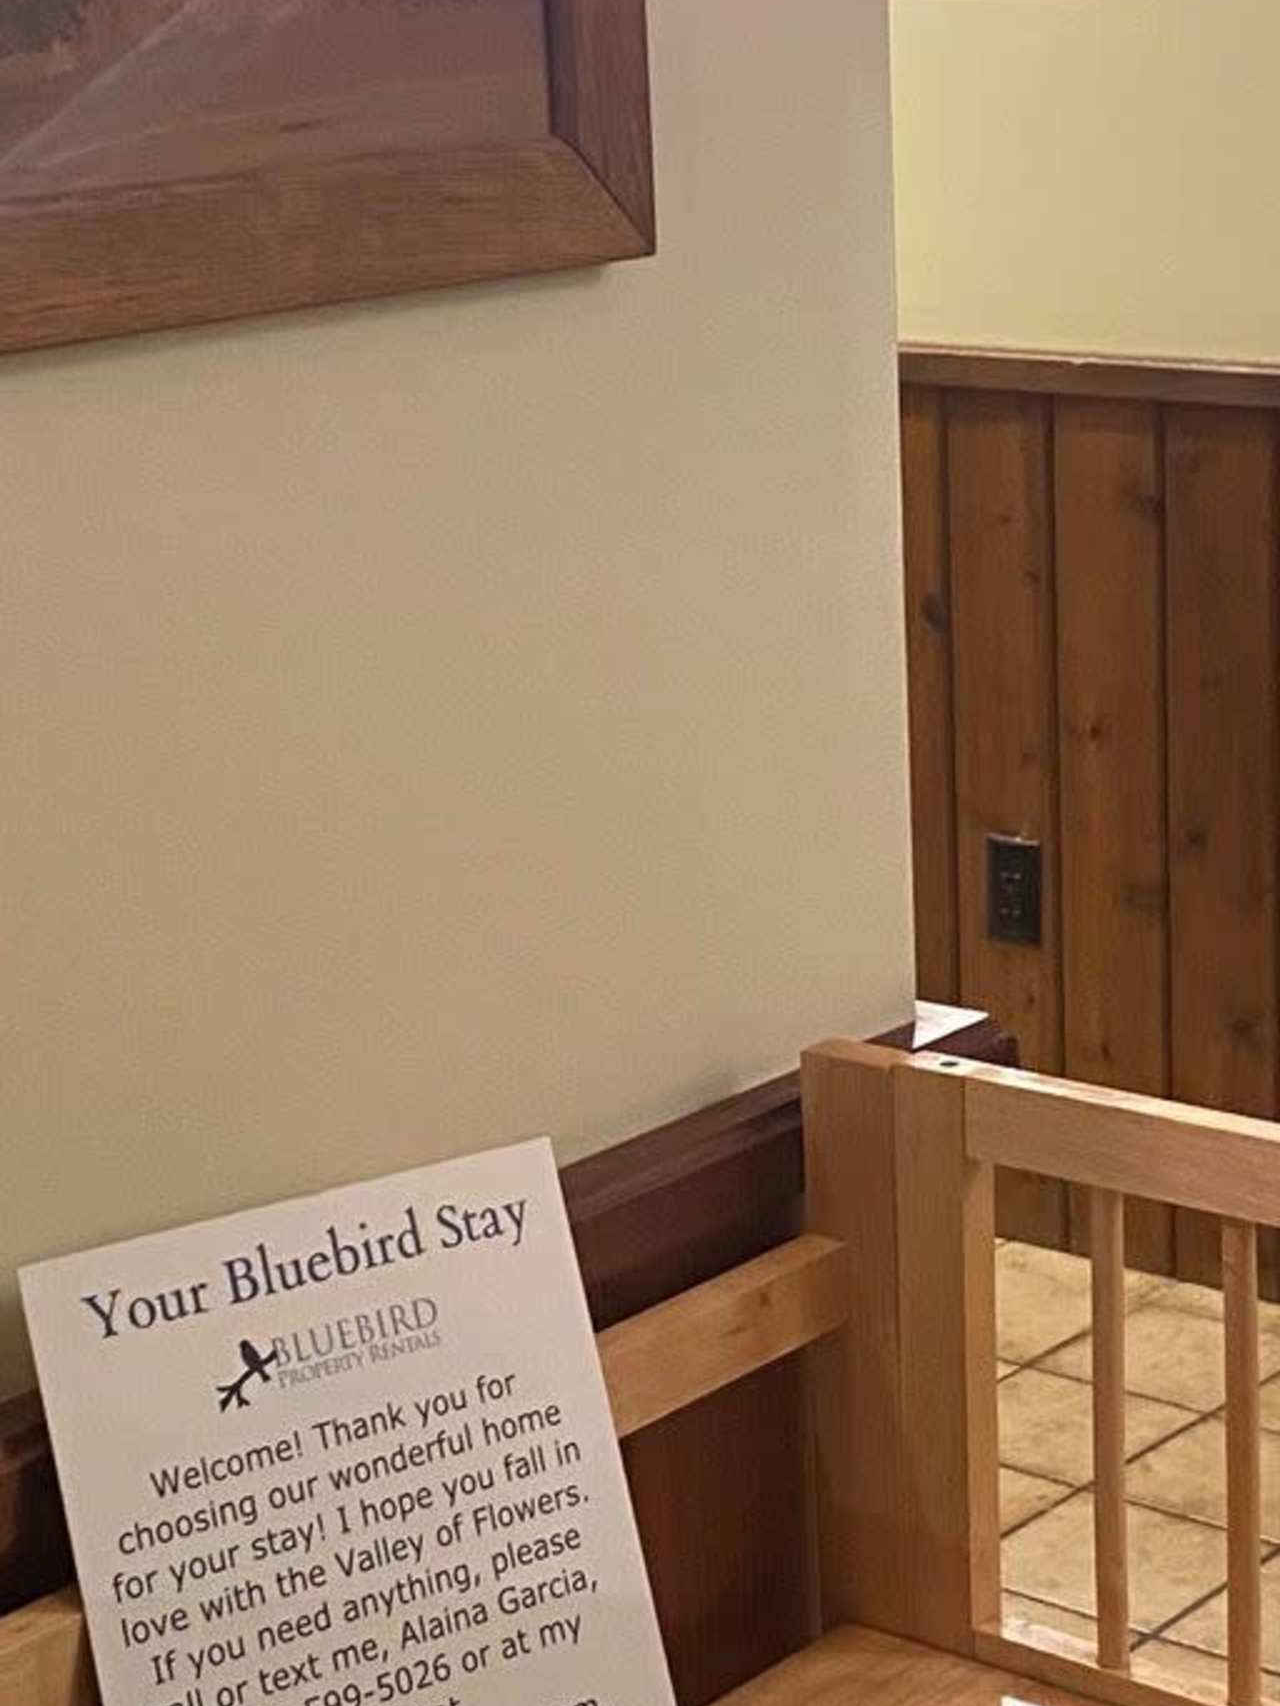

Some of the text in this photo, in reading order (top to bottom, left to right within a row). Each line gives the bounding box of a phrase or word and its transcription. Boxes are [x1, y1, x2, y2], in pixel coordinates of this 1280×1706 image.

[79, 1198, 527, 1339] Your Bluebird Stay
[271, 1296, 438, 1368] BLUEBIRD
[117, 1403, 562, 1556] choosing our wonderful home
[148, 1372, 516, 1499] Welcome! Thank you for
[111, 1438, 581, 1604] for your stay! I hope you fall in
[120, 1483, 589, 1648] love with the Valley of Flowers.
[150, 1527, 581, 1686] If you need anything, please
[257, 1652, 323, 1696] text
[330, 1637, 389, 1672] me,
[400, 1601, 489, 1652] Alaina
[496, 1567, 598, 1615] Garcia,
[460, 1643, 491, 1674] or
[500, 1628, 532, 1660] at
[538, 1613, 581, 1649] my
